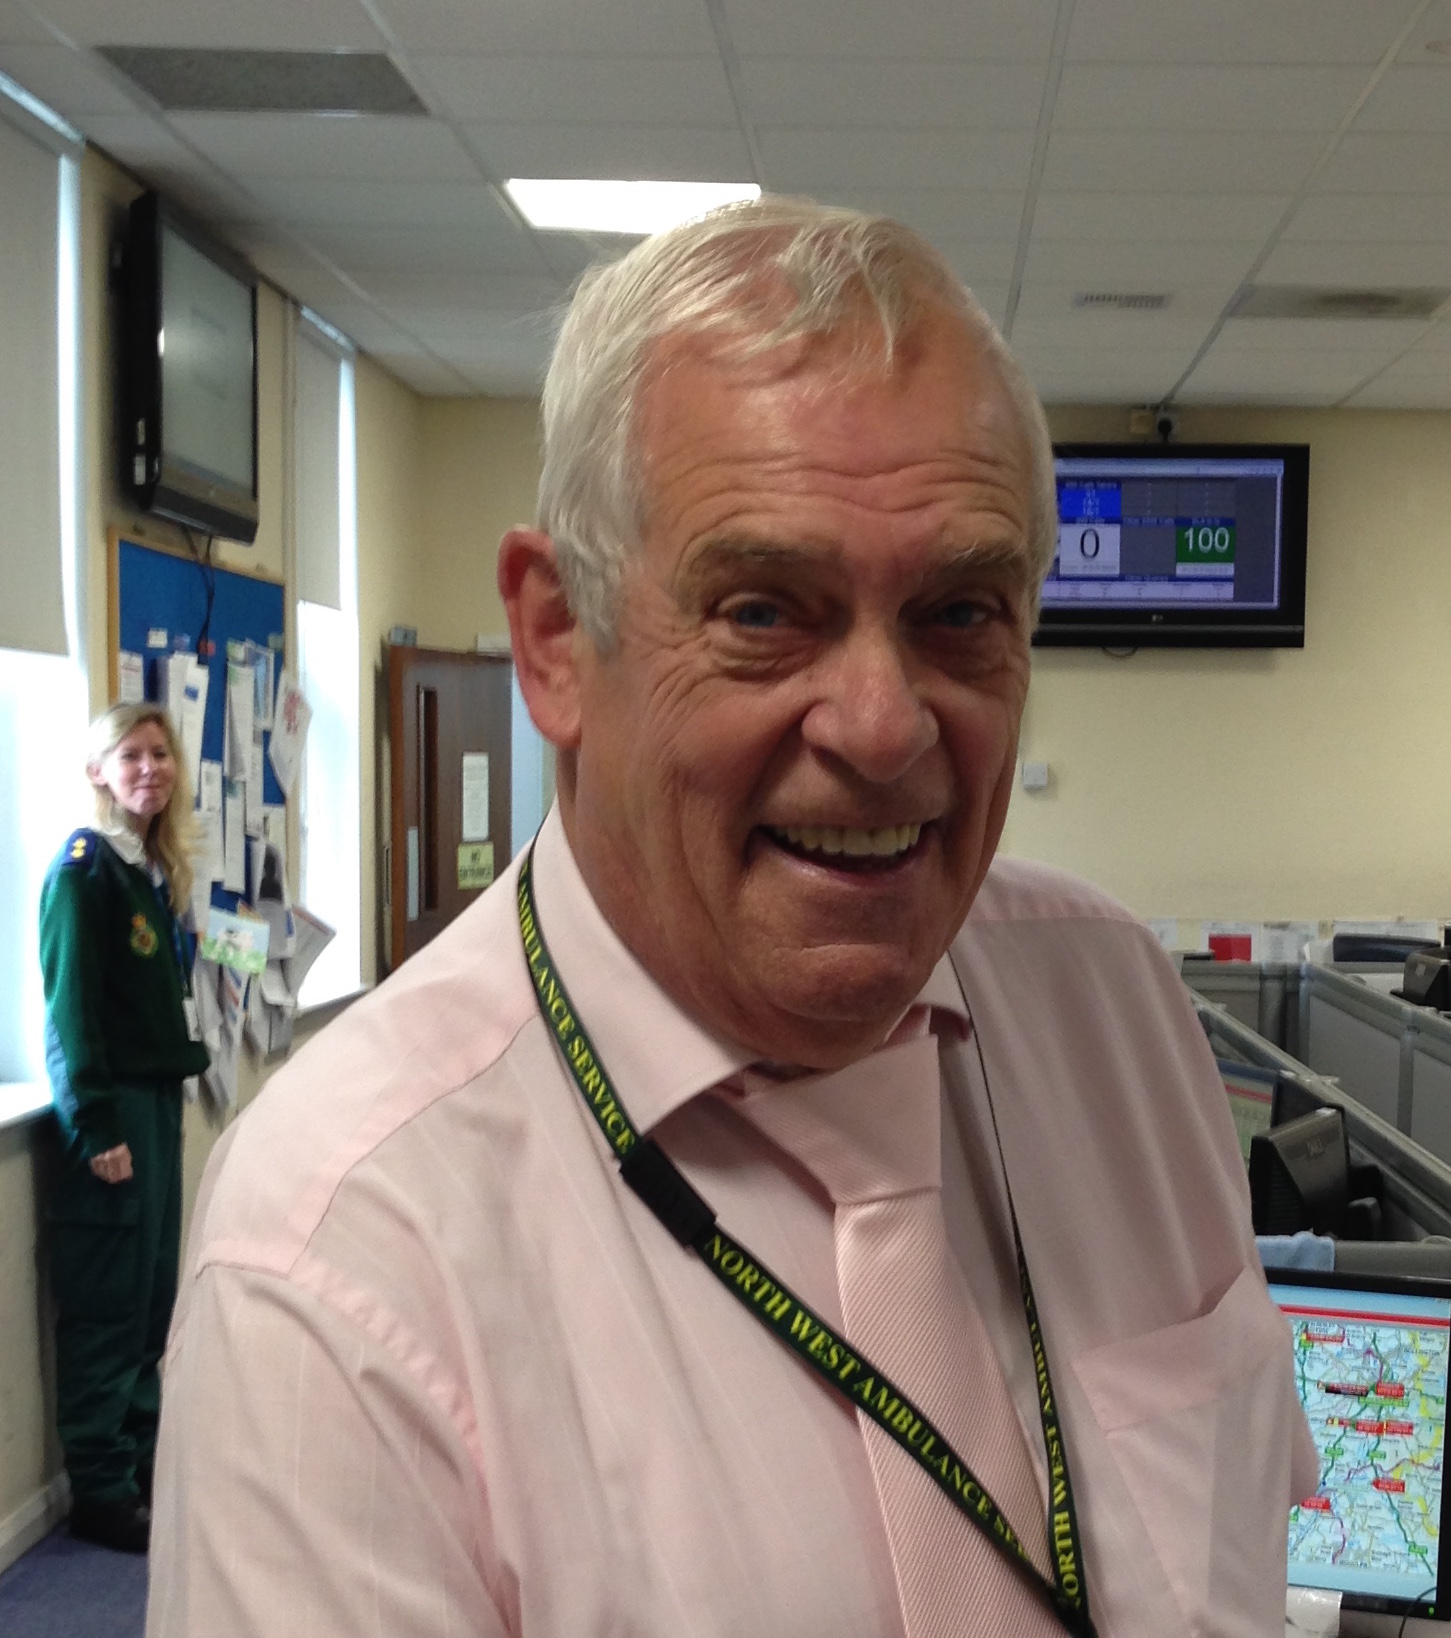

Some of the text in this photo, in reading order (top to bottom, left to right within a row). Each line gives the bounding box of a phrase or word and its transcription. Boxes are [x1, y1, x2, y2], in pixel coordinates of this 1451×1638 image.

[1081, 529, 1100, 558] 0
[1185, 527, 1230, 553] 100
[518, 881, 635, 1154] AMBULANCE SERVICE
[705, 1234, 991, 1521] NORTH WEST AMBULANCE
